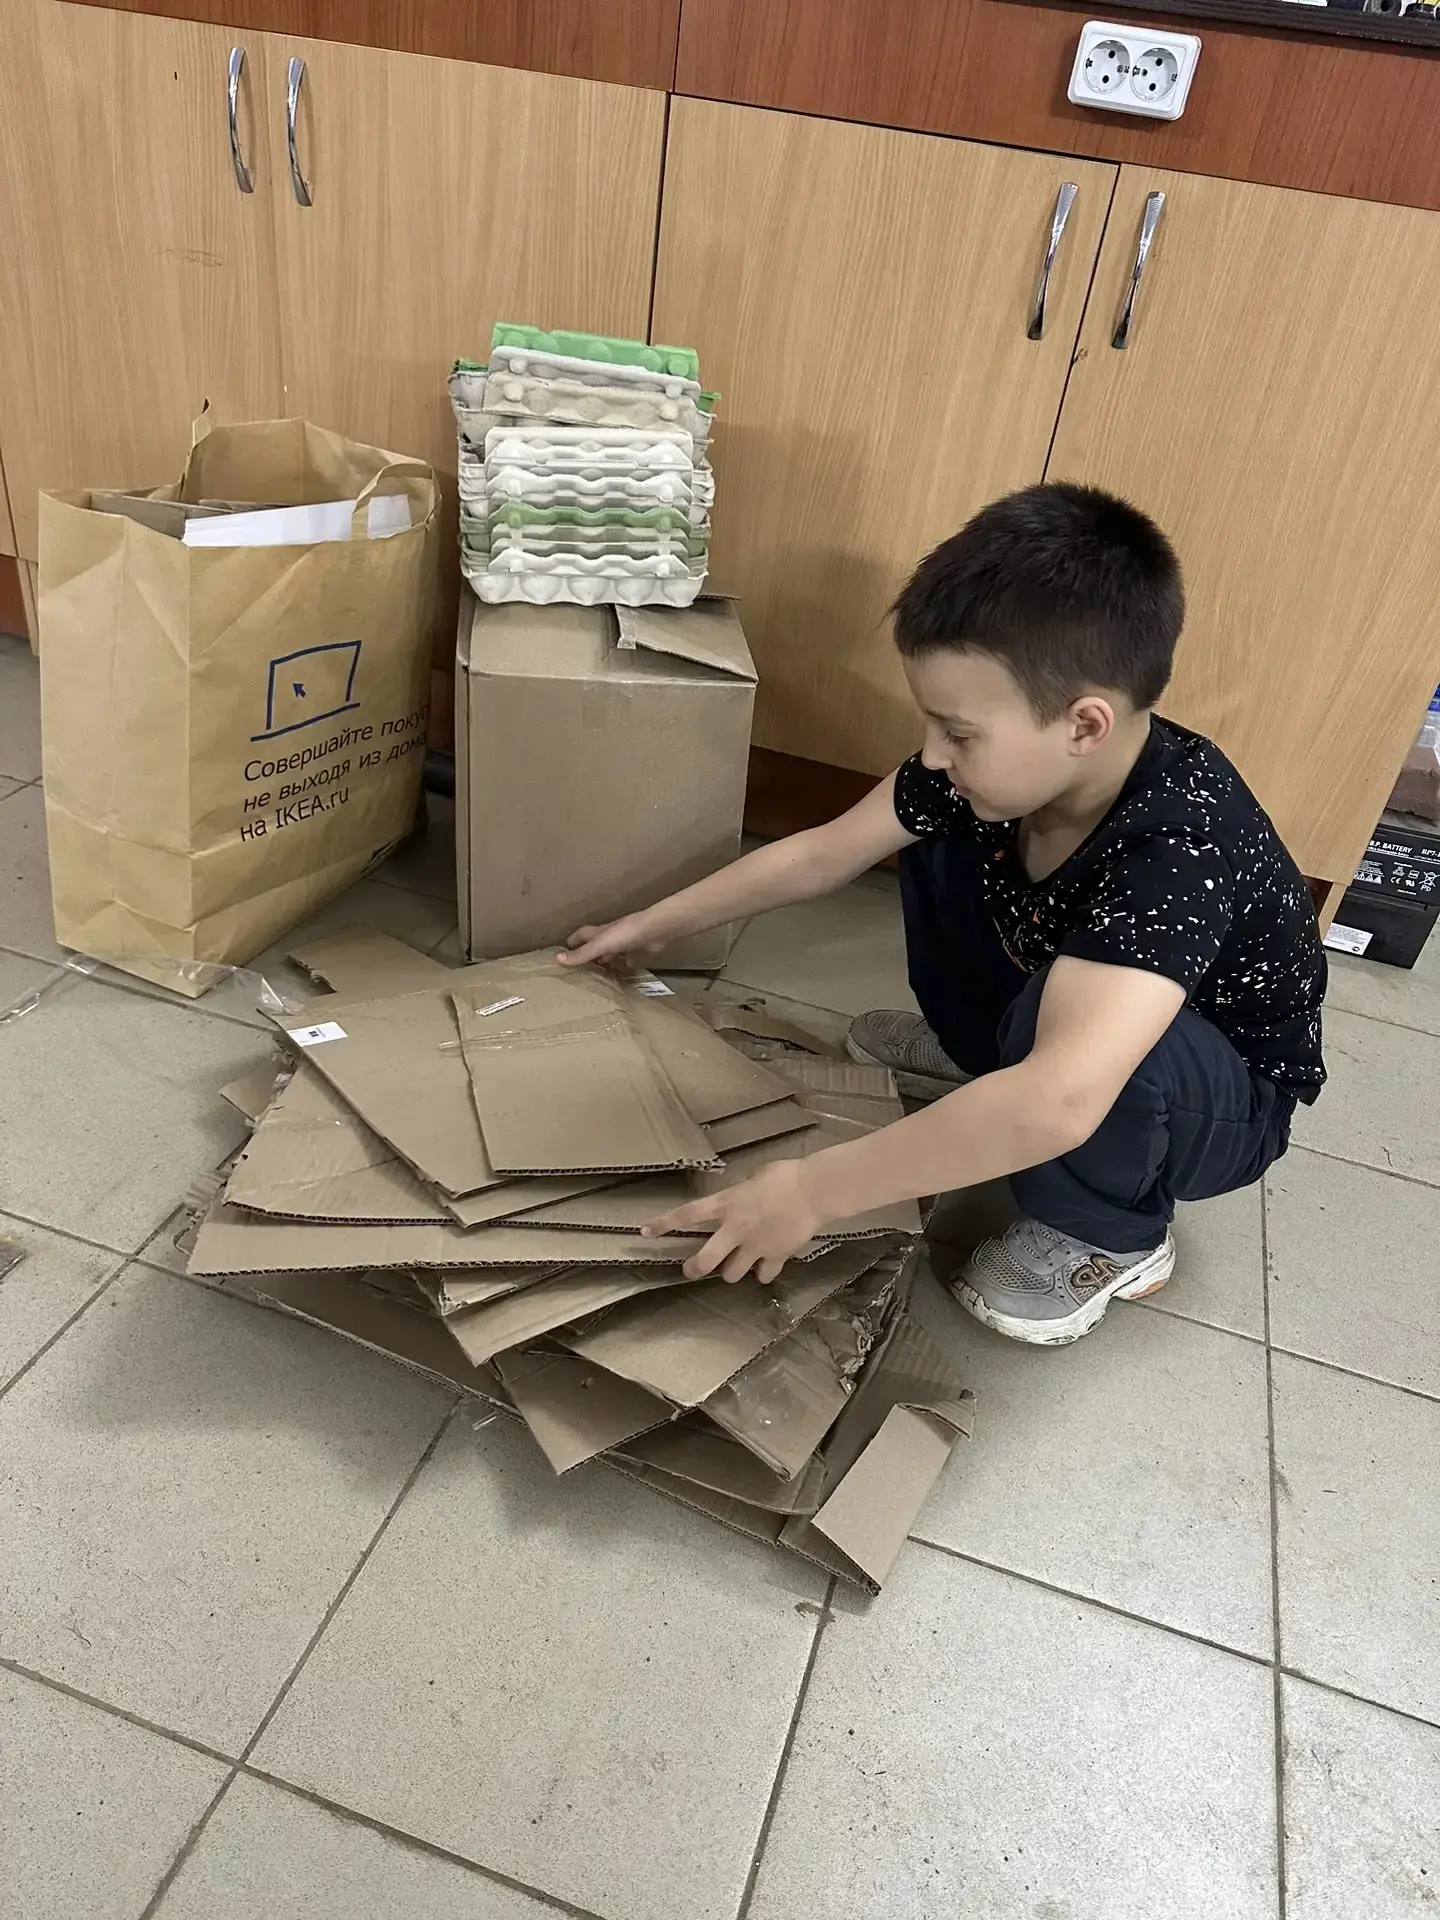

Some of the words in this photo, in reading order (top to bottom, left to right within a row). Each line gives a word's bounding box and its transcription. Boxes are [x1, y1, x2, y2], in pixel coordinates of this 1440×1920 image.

[243, 792, 271, 813] не
[278, 760, 350, 800] выходя
[359, 750, 381, 770] из
[386, 732, 427, 763] дома
[244, 725, 373, 782] Совершайте
[240, 819, 268, 842] на
[275, 787, 349, 829] IKEA.ru
[1382, 842, 1413, 853] BATTERY
